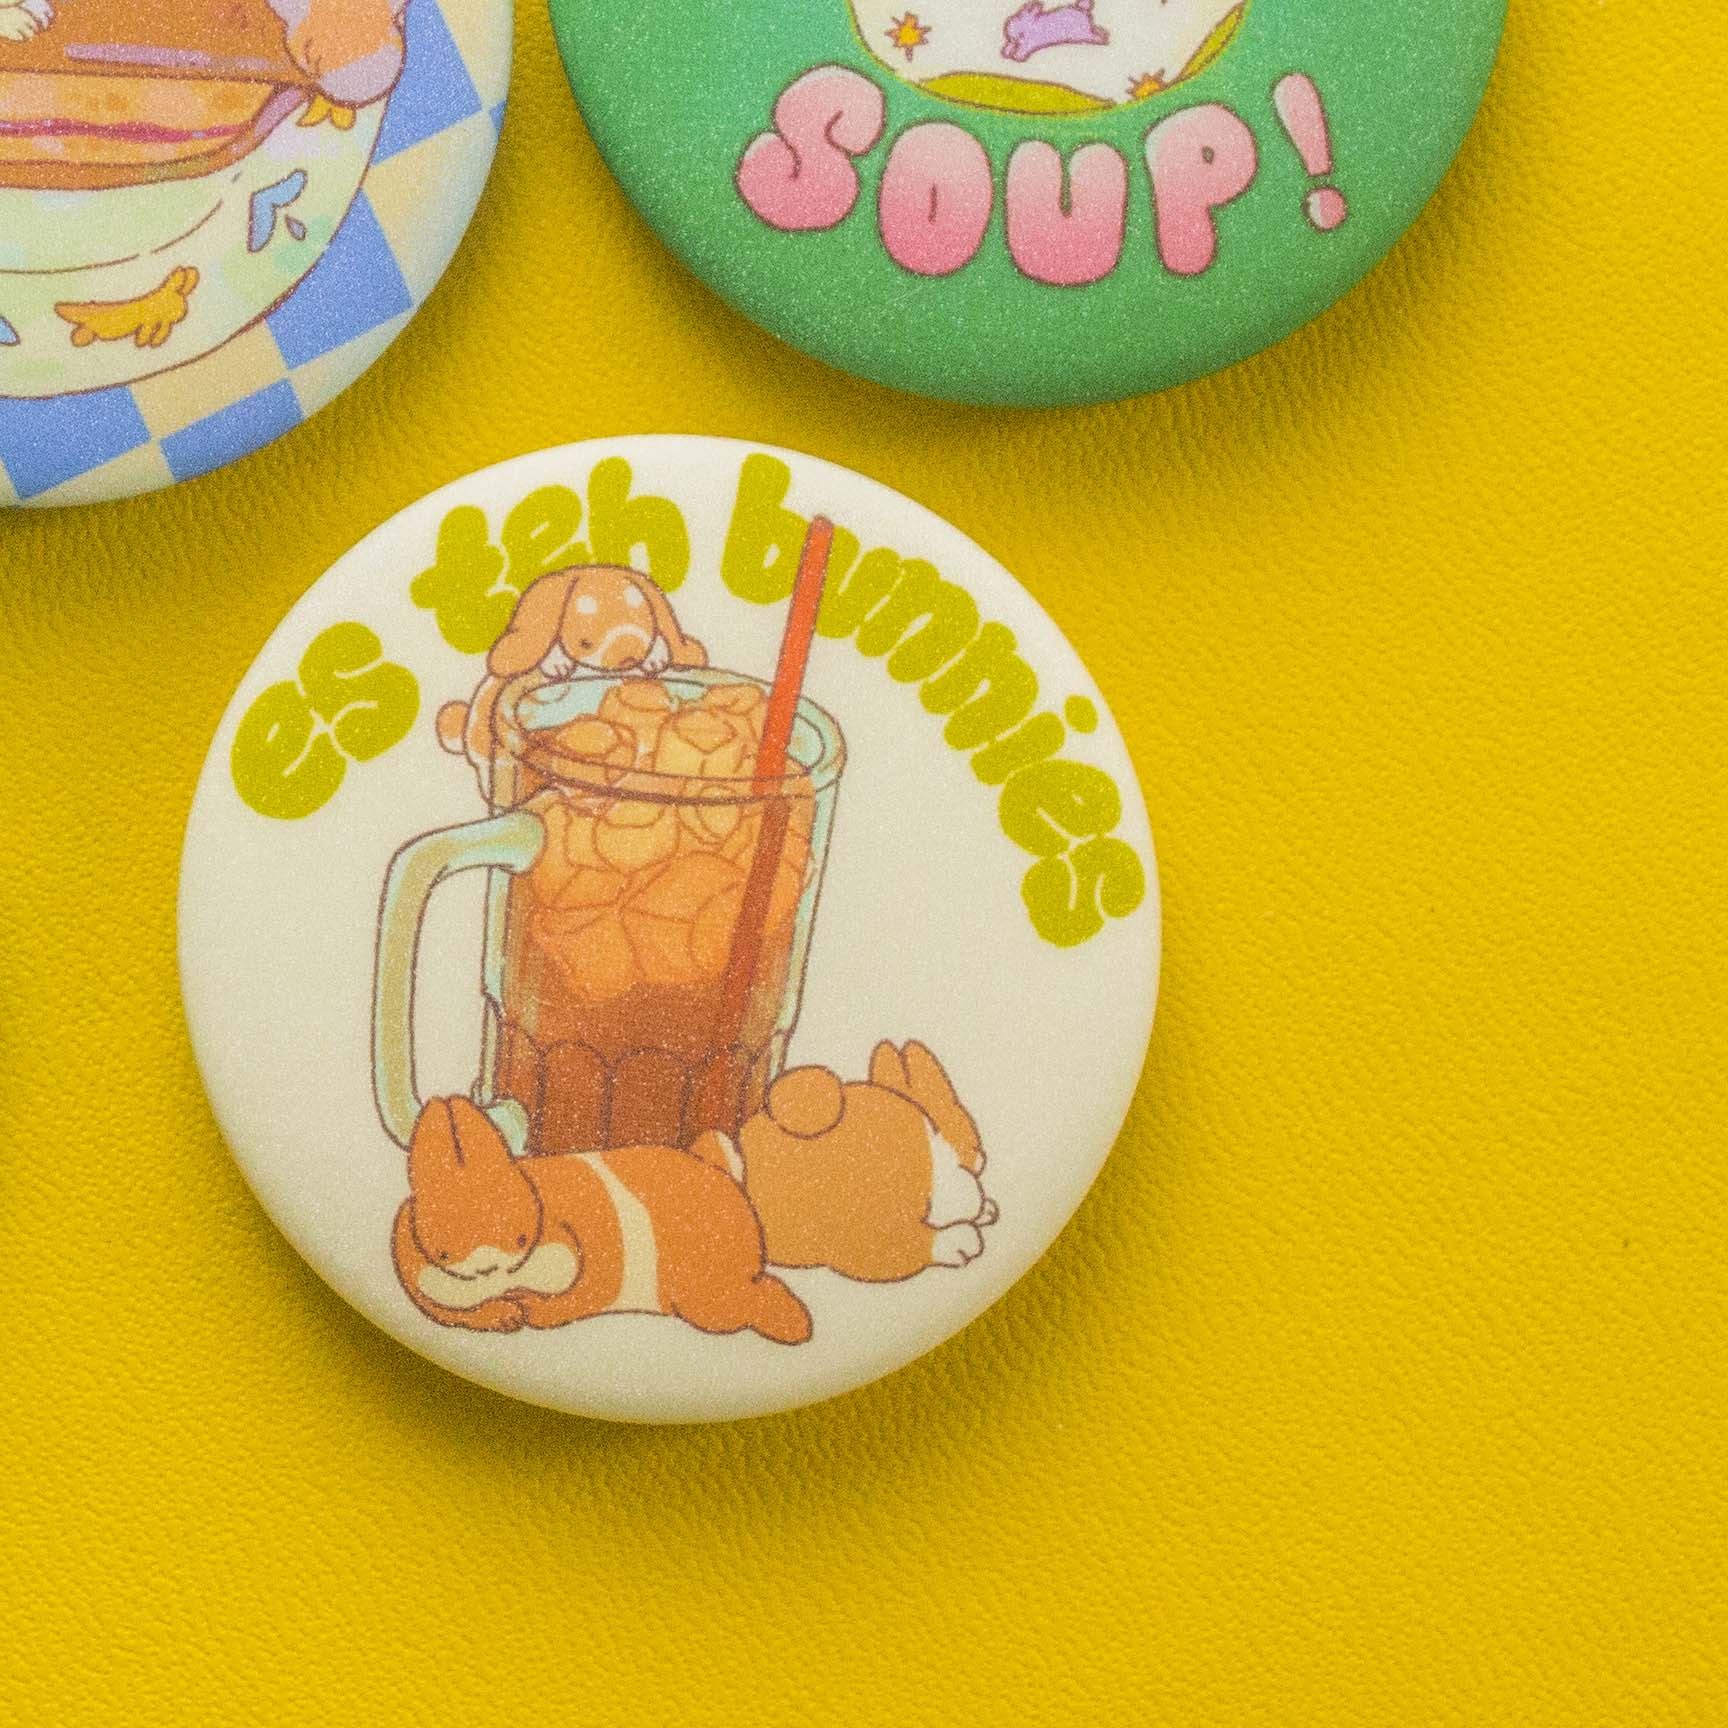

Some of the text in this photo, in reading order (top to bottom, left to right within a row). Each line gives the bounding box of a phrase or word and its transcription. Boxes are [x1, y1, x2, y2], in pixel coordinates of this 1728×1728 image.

[735, 64, 1348, 287] SOUP!
[230, 452, 1146, 948] es teh bunnies
